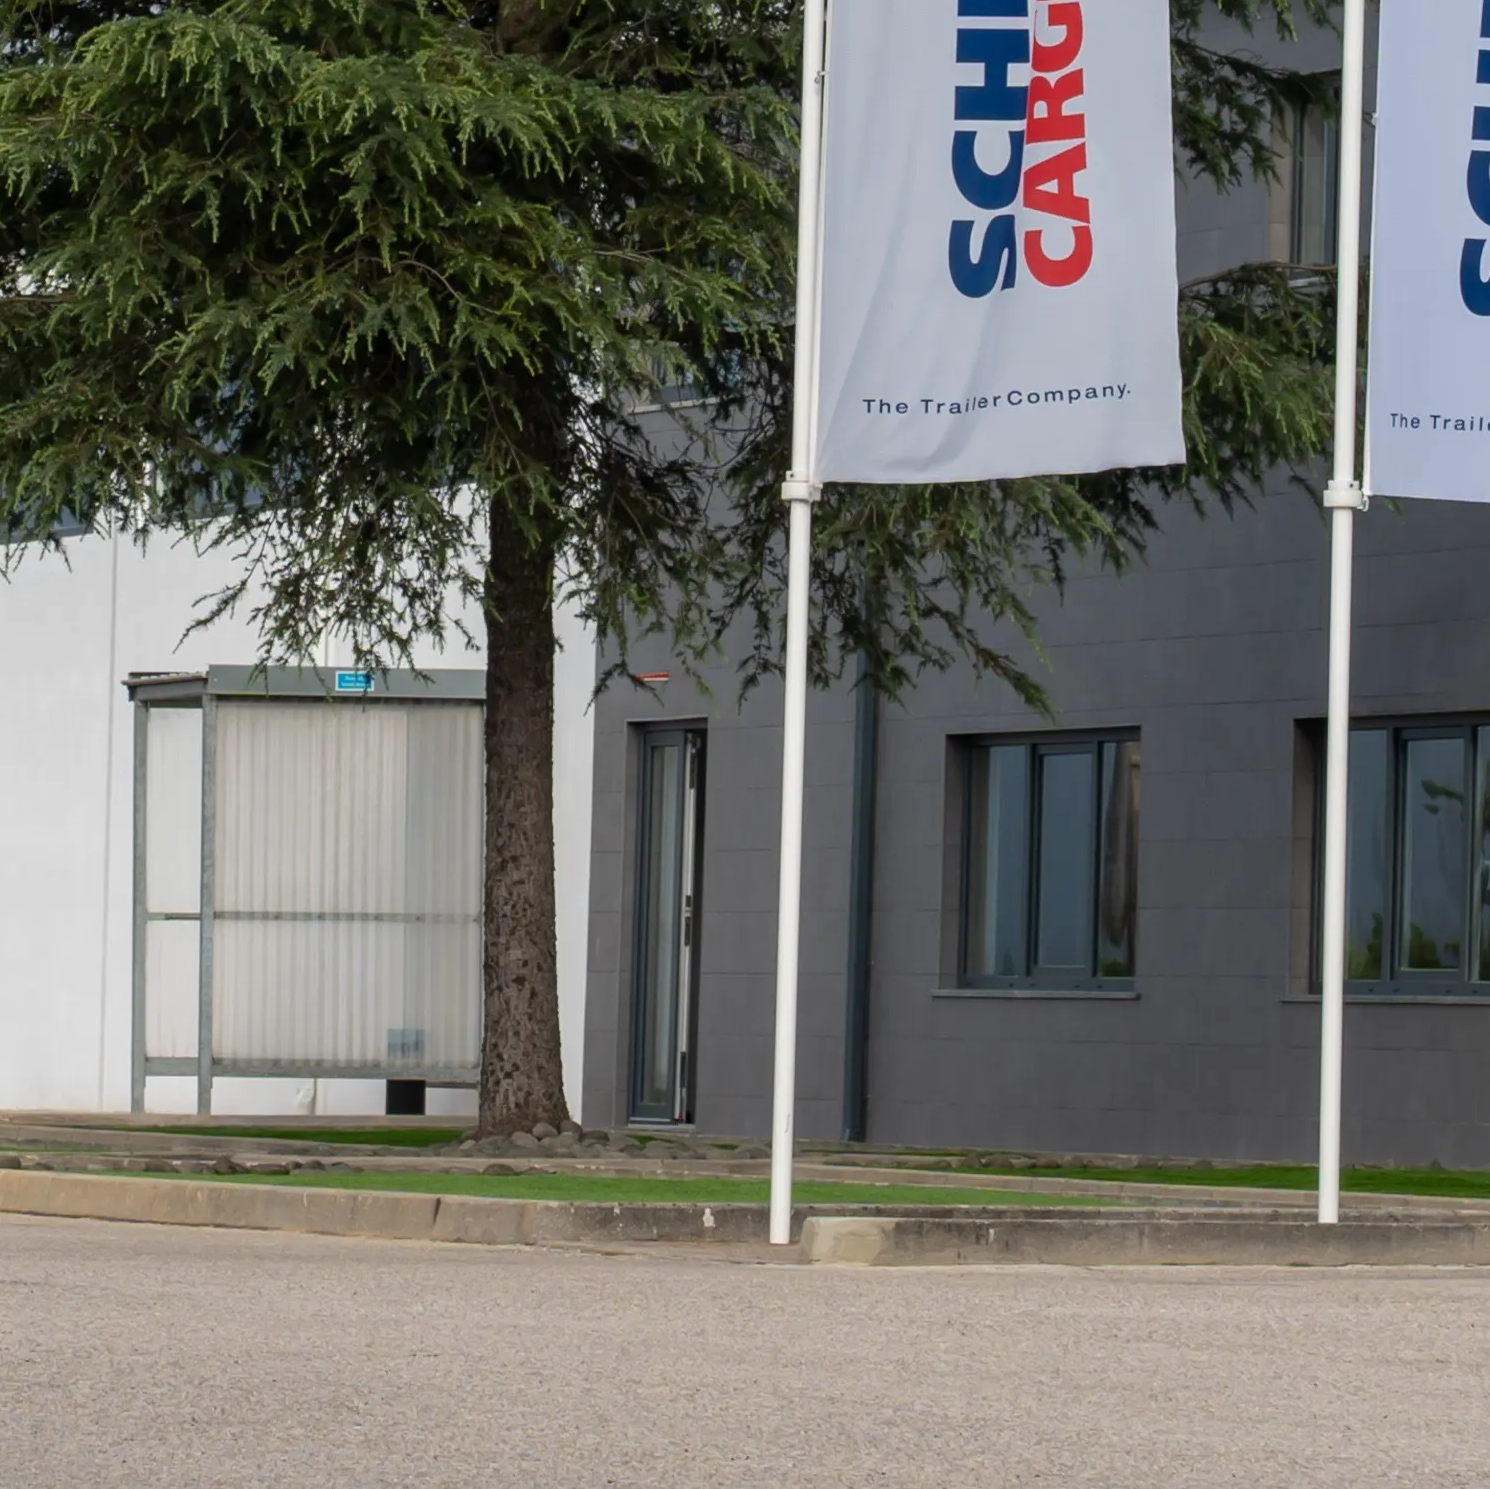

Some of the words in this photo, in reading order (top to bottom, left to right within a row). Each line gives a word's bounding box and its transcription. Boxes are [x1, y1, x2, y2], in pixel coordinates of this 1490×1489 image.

[863, 398, 909, 414] The
[921, 395, 1002, 414] Trailer
[1006, 383, 1132, 406] Company.
[1390, 413, 1421, 429] The
